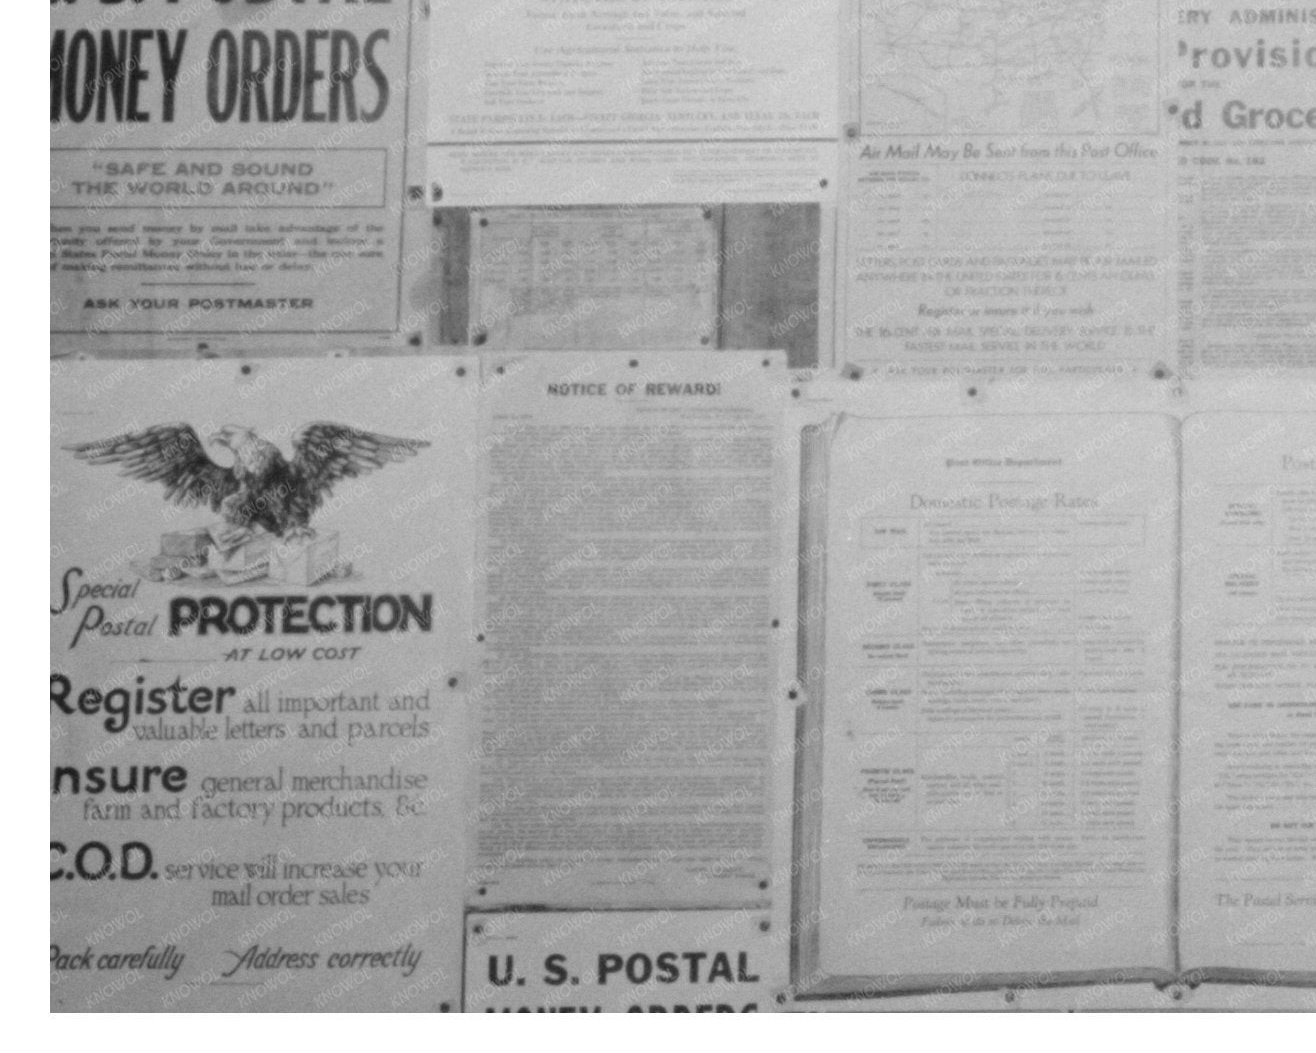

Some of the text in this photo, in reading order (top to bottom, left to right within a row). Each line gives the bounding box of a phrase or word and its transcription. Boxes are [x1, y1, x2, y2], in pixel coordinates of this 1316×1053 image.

[206, 28, 389, 123] ORDERS
[859, 145, 881, 160] Air
[885, 143, 920, 160] Mail
[924, 143, 959, 162] May
[963, 142, 981, 159] Be
[175, 163, 222, 176] AND
[231, 162, 314, 176] SOUND
[72, 182, 115, 195] THE
[128, 182, 212, 196] WORLD
[83, 298, 314, 309] ASK YOUR POSTMASTER
[547, 383, 607, 396] NOTICE
[615, 383, 636, 396] OF
[910, 494, 982, 509] Domestic
[50, 567, 141, 615] Special
[70, 593, 433, 649] Postal PROTECTION
[222, 647, 361, 662] AT LOW COST
[50, 673, 236, 733] Register
[132, 714, 430, 747] valuable letters parcels
[53, 765, 429, 800] nsure general merchandise
[191, 795, 275, 827] factory
[283, 856, 368, 879] increase
[212, 884, 370, 907] mail order sales
[97, 941, 423, 980] carefully Address correctly
[488, 951, 760, 986] U. S. POSTAL
